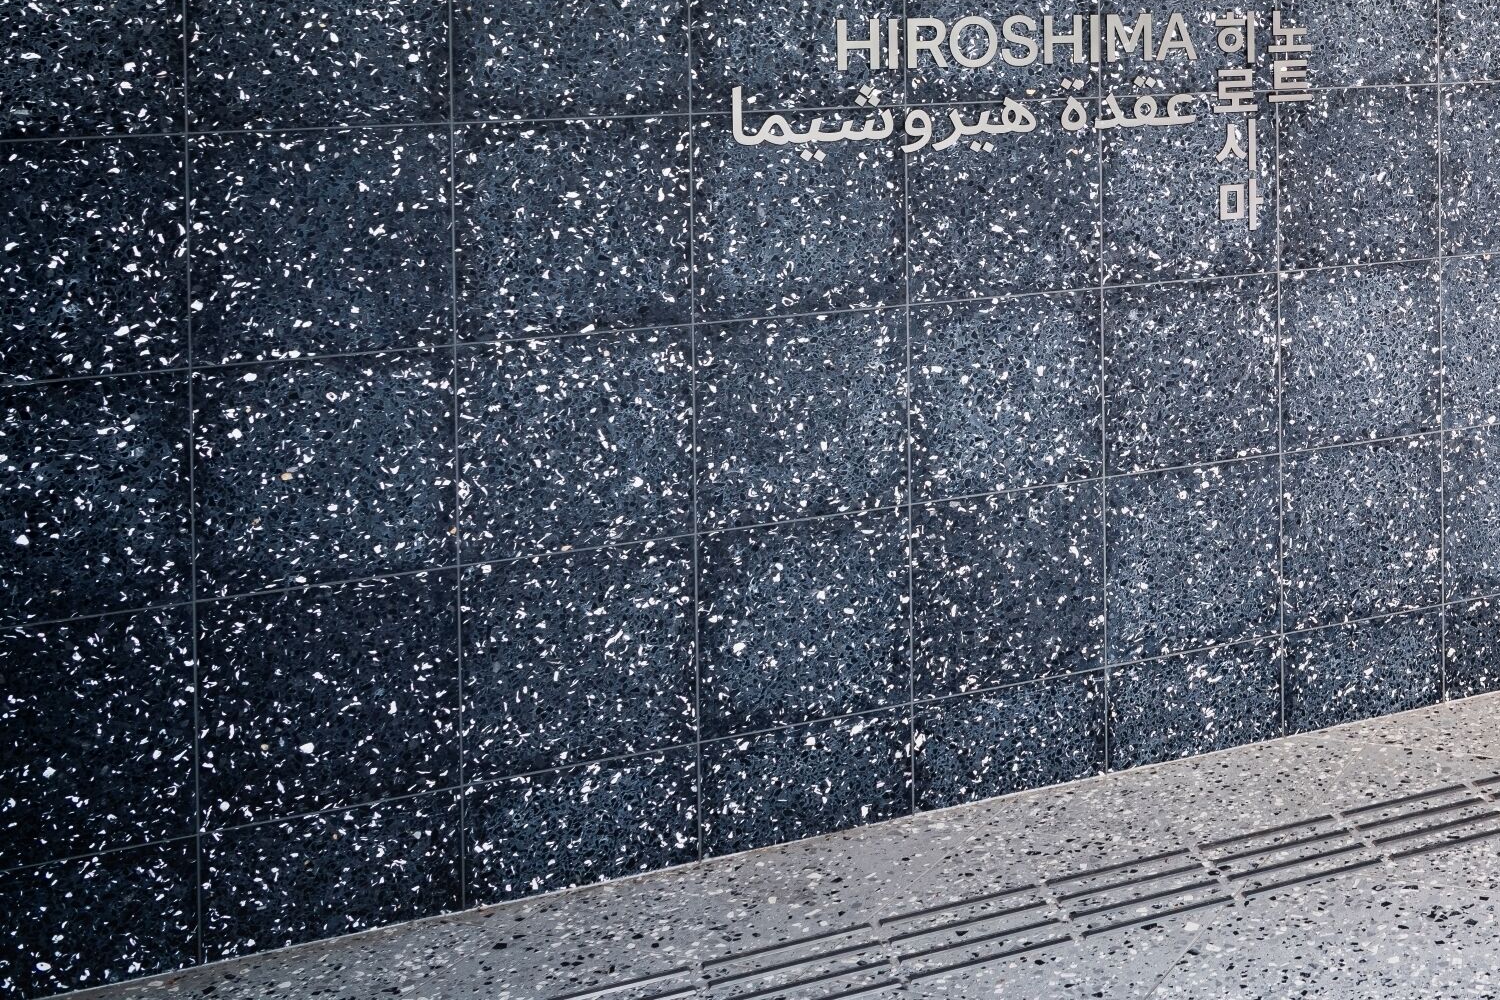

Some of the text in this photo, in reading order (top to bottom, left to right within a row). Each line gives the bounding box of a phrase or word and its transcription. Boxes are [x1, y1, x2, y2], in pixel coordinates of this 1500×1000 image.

[835, 12, 1198, 71] HIROSHIMA
[1267, 10, 1313, 104] 노트
[730, 74, 1198, 163] عقدة هيروشيما
[1213, 10, 1264, 231] 히로시마
